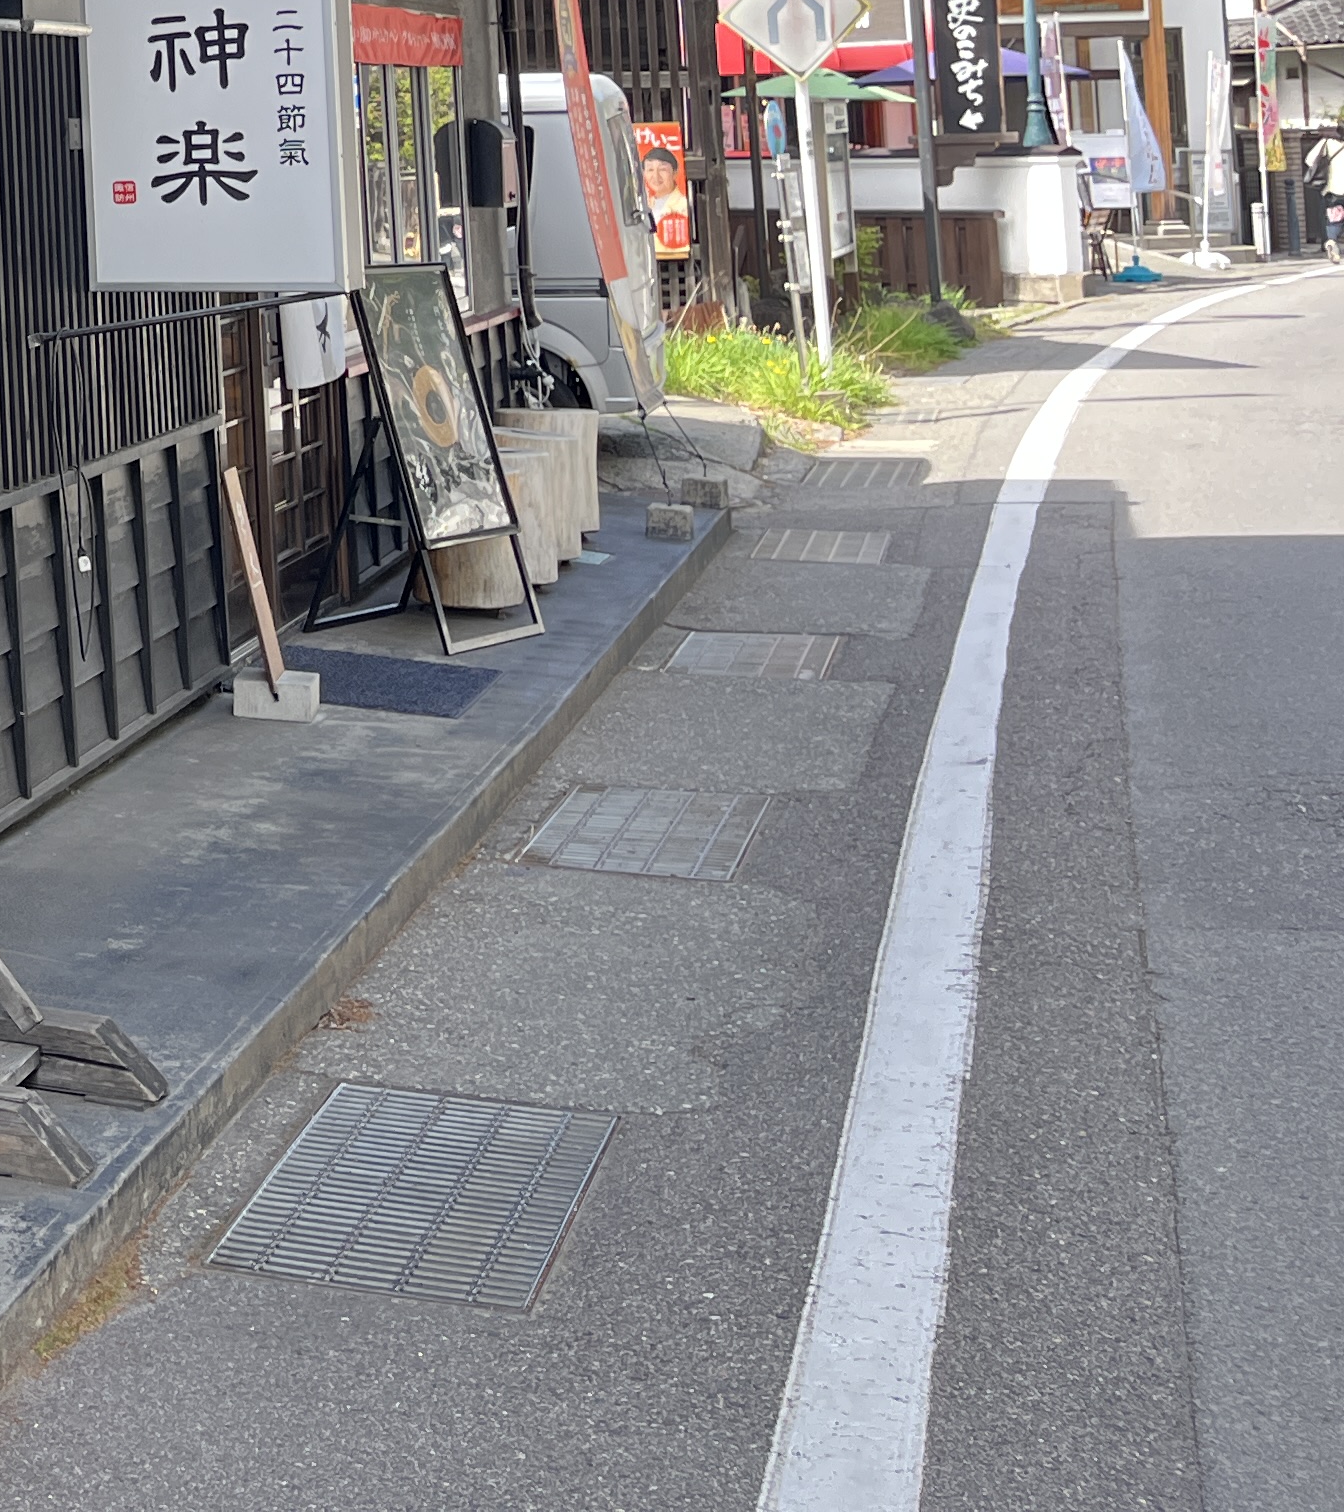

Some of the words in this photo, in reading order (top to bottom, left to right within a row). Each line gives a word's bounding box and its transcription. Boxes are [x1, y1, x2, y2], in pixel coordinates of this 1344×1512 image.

[147, 7, 259, 207] 神楽
[272, 9, 310, 167] 二十四節氣
